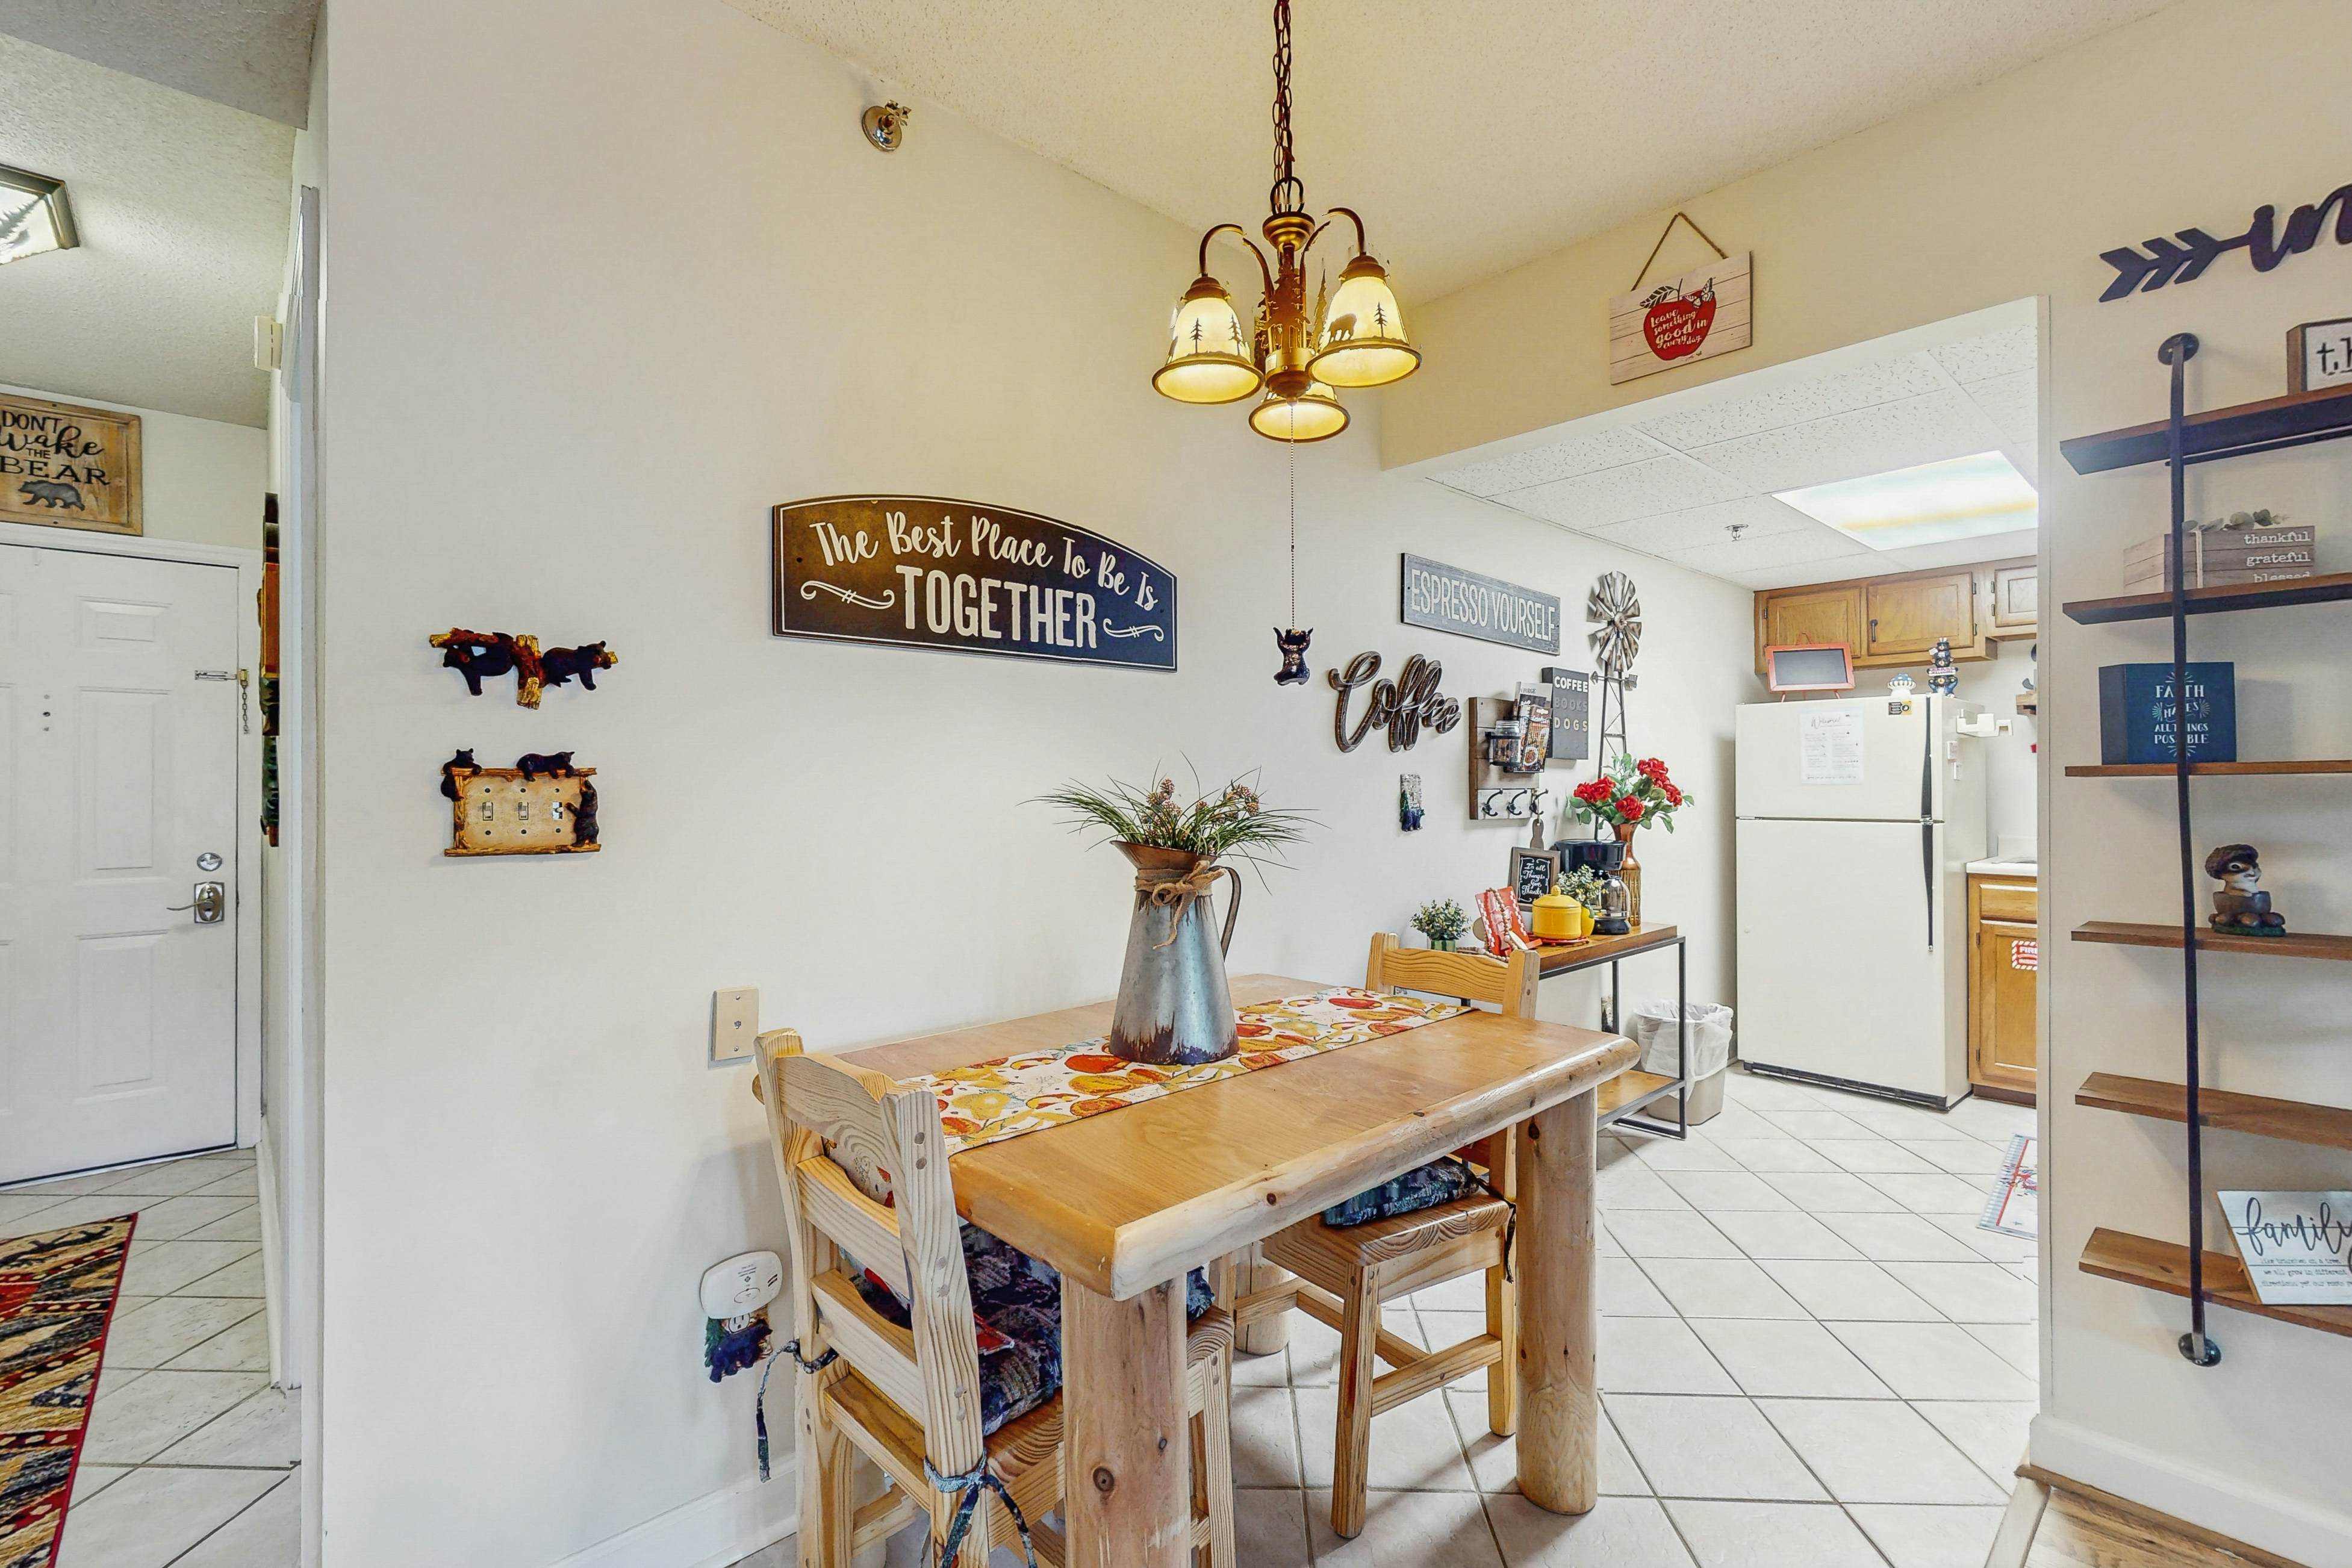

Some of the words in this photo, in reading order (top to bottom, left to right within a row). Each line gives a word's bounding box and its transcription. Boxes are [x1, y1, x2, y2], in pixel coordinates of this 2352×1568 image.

[1651, 309, 1679, 328] Leave
[1654, 311, 1697, 335] something
[1655, 319, 1696, 348] good
[1697, 319, 1708, 329] in
[25, 447, 51, 459] THE
[0, 455, 110, 485] BEAR
[2244, 531, 2311, 544] thankful
[809, 522, 879, 567] The
[886, 511, 962, 558] Best
[972, 515, 1053, 567] Place
[1062, 537, 1090, 578] To
[1098, 552, 1130, 596] Be
[1134, 571, 1158, 612] Is
[2246, 552, 2311, 567] grateful
[896, 565, 1097, 649] TOGETHER
[1411, 568, 1488, 627] ESPRESSO
[1492, 592, 1555, 641] YOURSELF
[1554, 676, 1588, 692] COFFEE
[2156, 685, 2204, 698] FATH
[1328, 651, 1461, 753] Coffee
[2164, 702, 2199, 718] MES
[1554, 717, 1588, 732] DOGS
[2154, 724, 2171, 732] ALL
[2172, 723, 2209, 732] TINGS
[2154, 734, 2210, 744] POSBLE
[1523, 870, 1545, 882] Things
[2236, 1196, 2352, 1275] family
